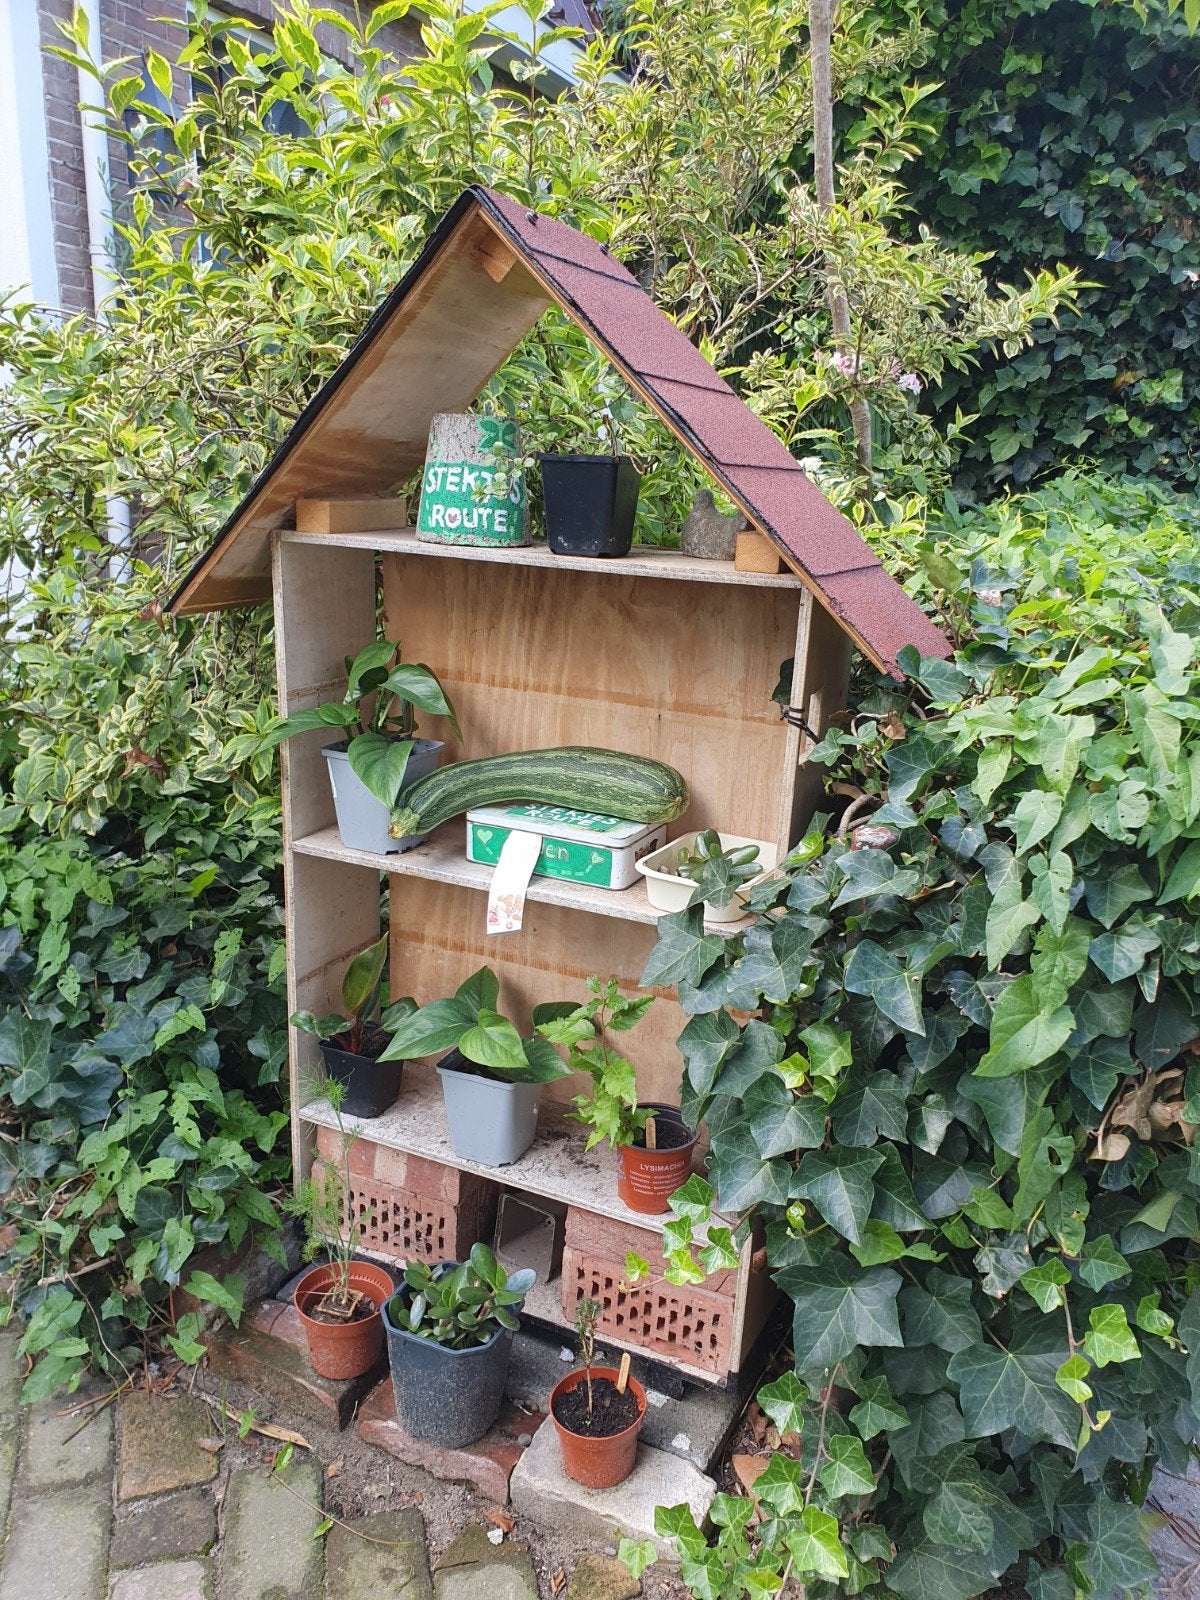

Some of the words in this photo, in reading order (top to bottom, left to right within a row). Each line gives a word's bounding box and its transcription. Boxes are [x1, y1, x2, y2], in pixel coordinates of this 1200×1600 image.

[426, 466, 521, 504] STEKJS
[431, 504, 508, 533] ROUTE
[525, 810, 595, 827] ROUTE
